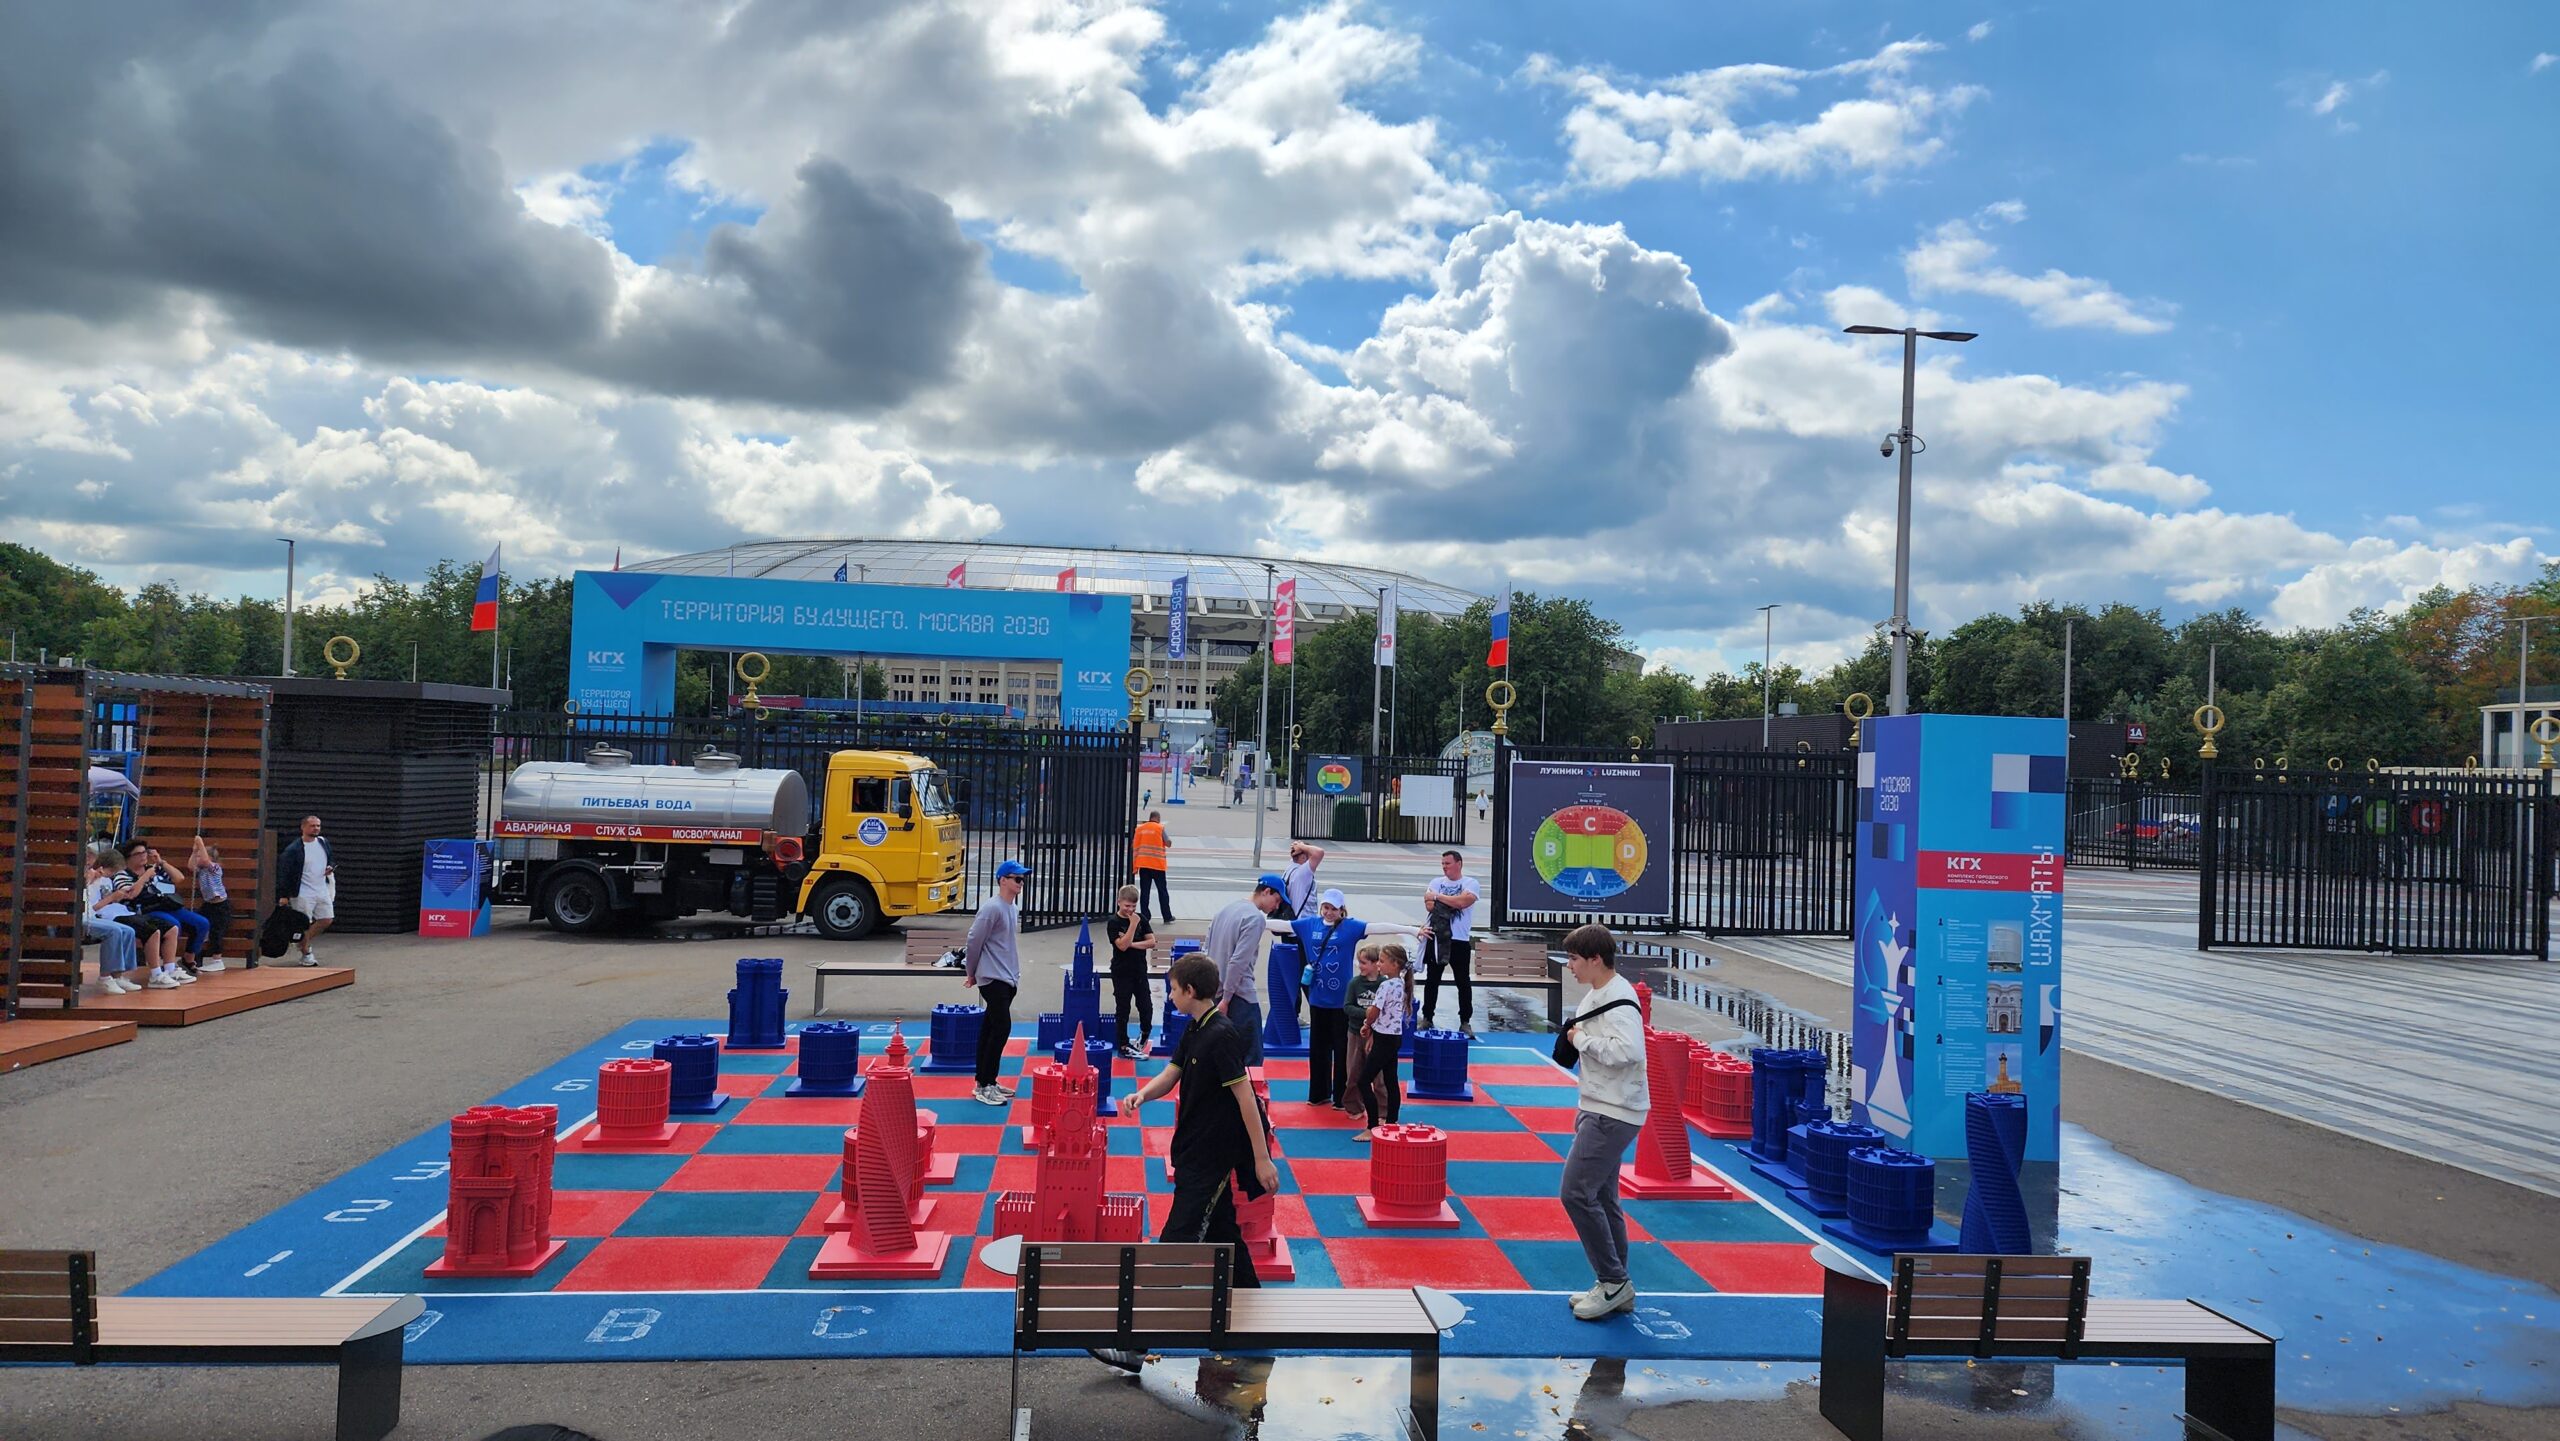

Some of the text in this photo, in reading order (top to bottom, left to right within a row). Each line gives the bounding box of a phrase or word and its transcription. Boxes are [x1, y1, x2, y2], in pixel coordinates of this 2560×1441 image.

[660, 599, 1050, 636] ТЕРРИТОРИЯ БУДУЩЕГО. МОСКВА 2030
[587, 650, 625, 665] КГХ
[1077, 670, 1113, 685] КГХ
[580, 688, 632, 700] ТЕРРИТОРИЯ
[1539, 766, 1641, 778] ЛУЖНИКИ LUZHNIKI
[1880, 776, 1911, 792] МОСКВА
[582, 797, 693, 810] ПИТЬЕВАЯ ВОДА
[1880, 794, 1899, 811] 2030
[504, 822, 572, 834] АВАРИЙНАЯ
[1583, 816, 1597, 832] C
[1545, 841, 1557, 857] B
[1623, 844, 1636, 859] D
[1947, 856, 1982, 871] КГХ
[1583, 871, 1597, 886] A
[2029, 845, 2055, 966] ШАХМАТЫ
[428, 914, 447, 922] КГХ
[323, 1199, 394, 1222] 2
[584, 1307, 662, 1343] B
[812, 1305, 875, 1339] C
